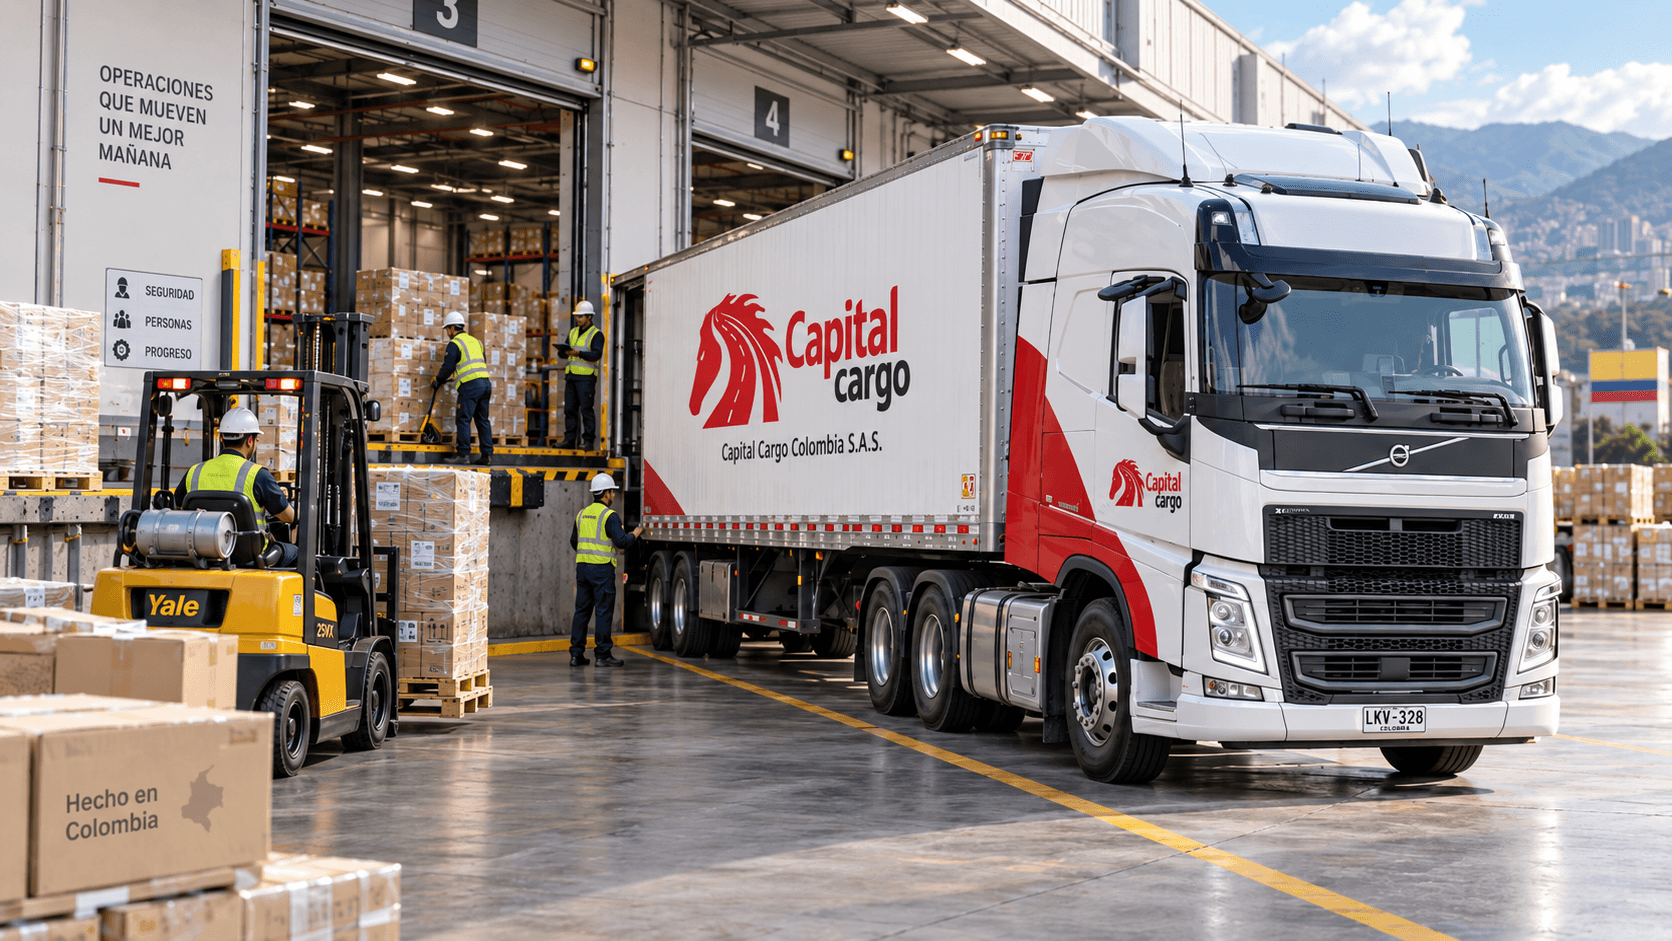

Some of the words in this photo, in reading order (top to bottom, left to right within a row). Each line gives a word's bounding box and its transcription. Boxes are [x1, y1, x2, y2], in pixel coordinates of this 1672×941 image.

[100, 65, 213, 101] OPERACIONES
[100, 91, 134, 113] QUE
[140, 98, 206, 125] MUEVEN
[766, 100, 780, 137] 4
[100, 117, 123, 137] UN
[129, 122, 184, 147] MEJOR
[99, 143, 172, 170] MAÑANA
[145, 285, 194, 300] SEGURIDAD
[145, 316, 192, 330] PERSONAS
[785, 285, 898, 380] Capital
[145, 346, 192, 360] PROGRESO
[834, 359, 911, 412] cargo
[721, 440, 755, 465] Capital
[758, 440, 788, 463] Cargo
[791, 434, 844, 456] Colombia
[848, 431, 882, 453] S.A.S.
[1146, 471, 1181, 495] Capital
[1155, 495, 1182, 513] cargo
[149, 594, 199, 617] Yale
[1366, 710, 1423, 725] LKV-328
[66, 788, 129, 813] Hecho
[135, 787, 158, 804] en
[65, 810, 159, 841] Colombia
